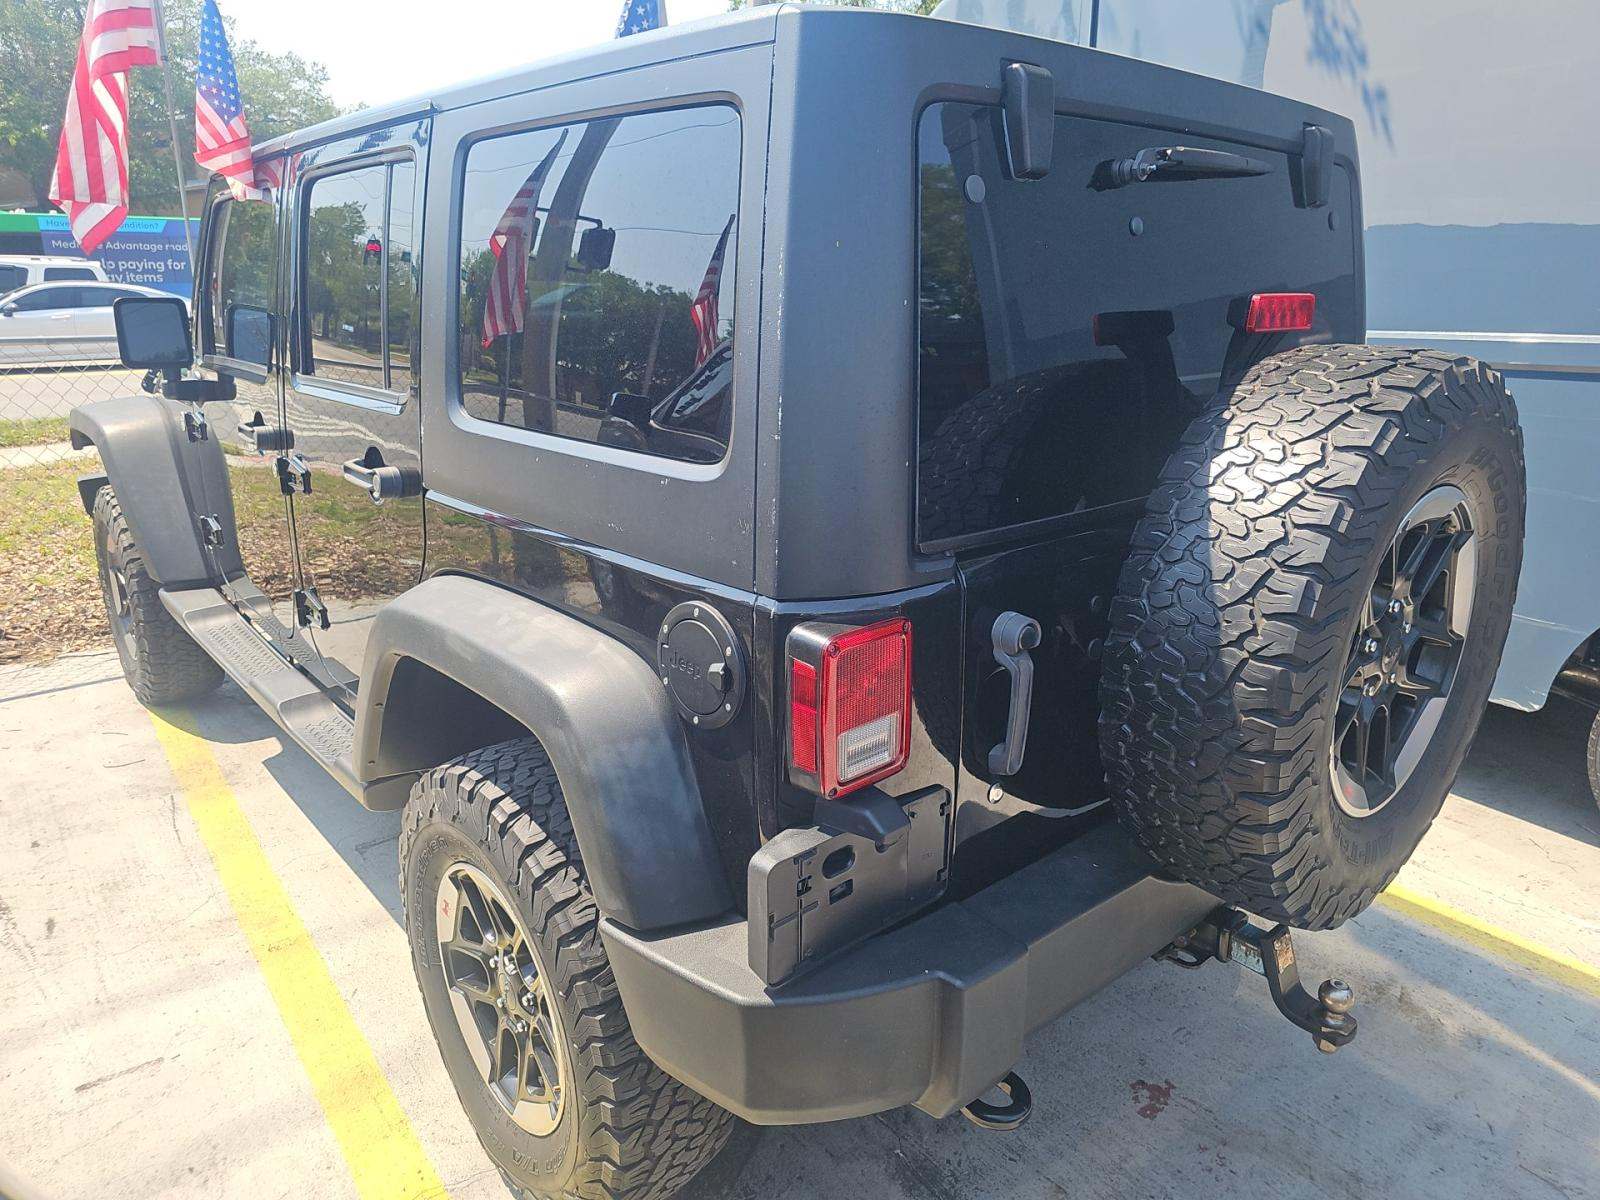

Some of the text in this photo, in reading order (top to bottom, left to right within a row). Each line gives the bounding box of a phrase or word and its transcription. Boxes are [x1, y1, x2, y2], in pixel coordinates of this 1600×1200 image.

[105, 241, 163, 253] Advantage
[118, 259, 165, 272] paying
[166, 259, 187, 270] for
[126, 271, 164, 283] items
